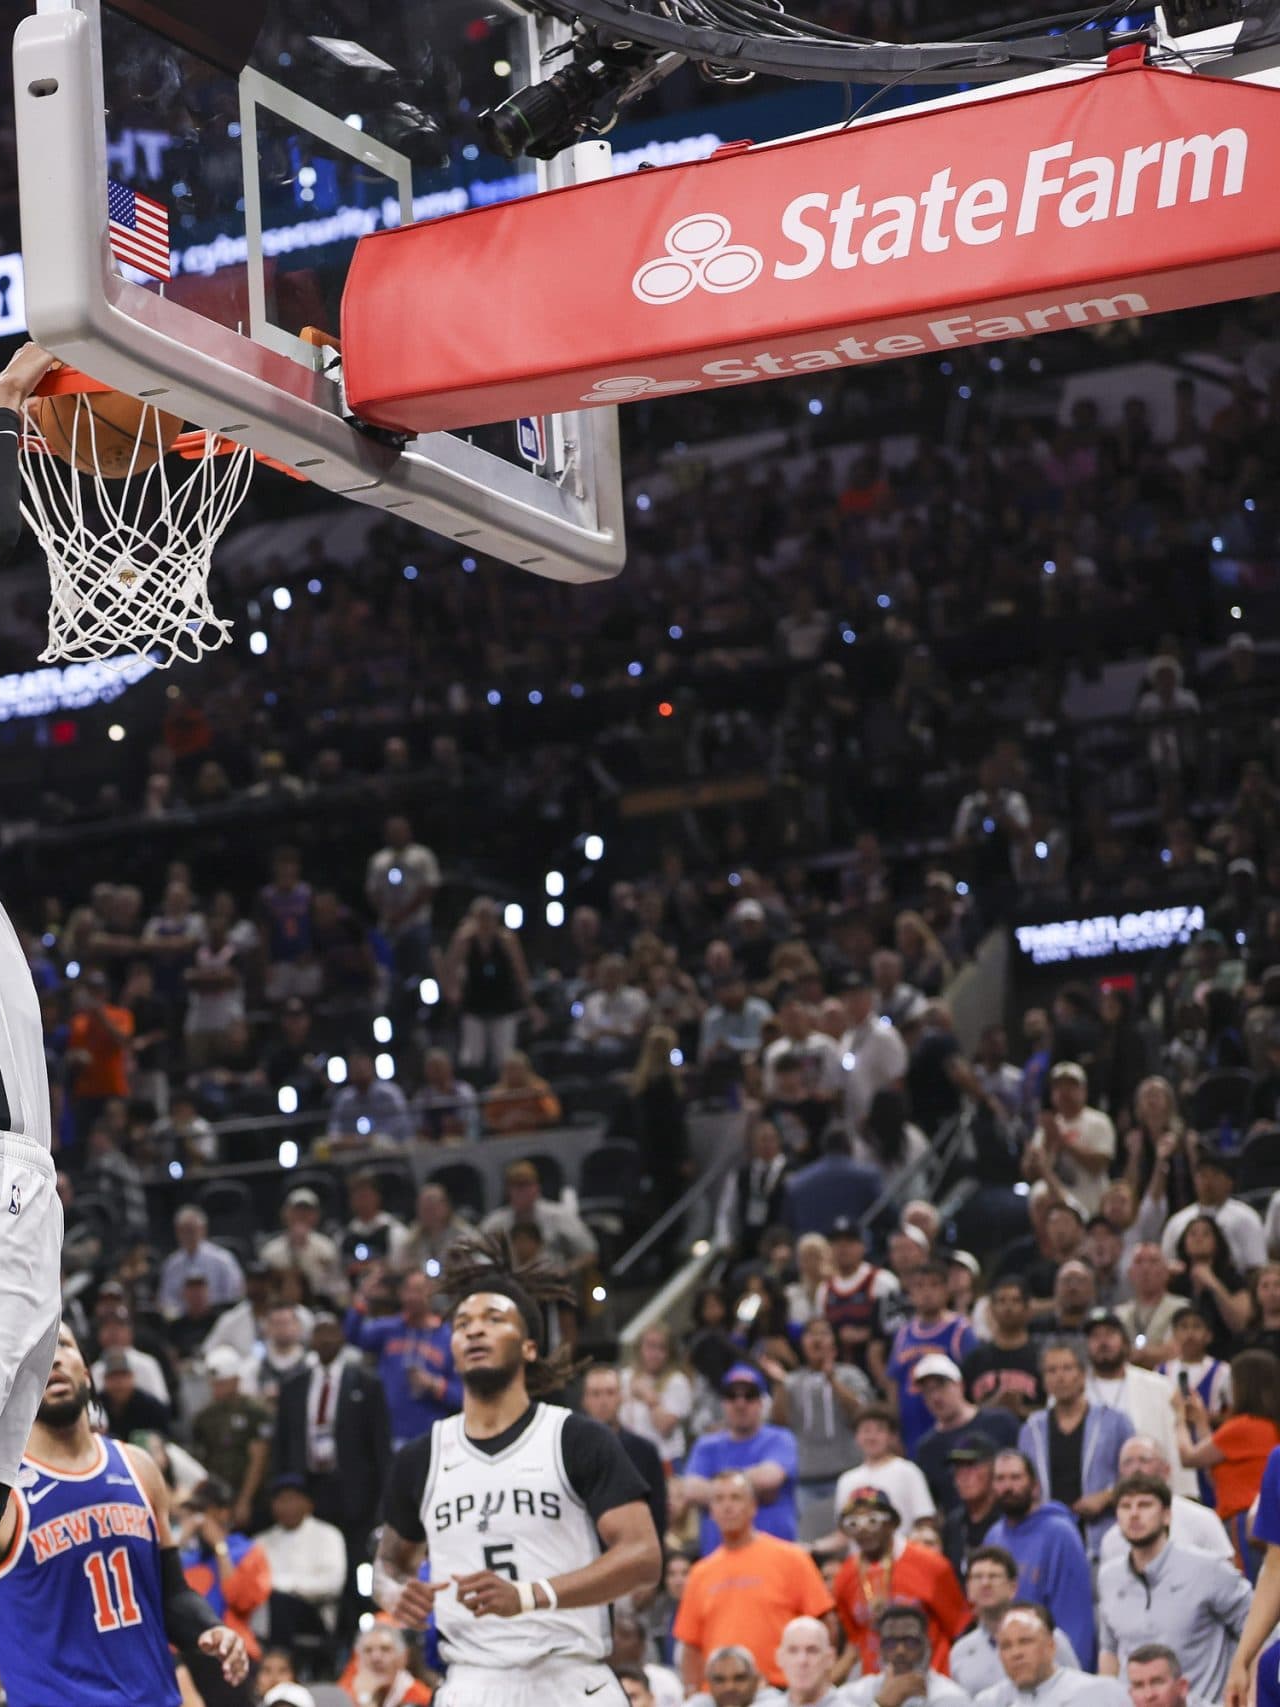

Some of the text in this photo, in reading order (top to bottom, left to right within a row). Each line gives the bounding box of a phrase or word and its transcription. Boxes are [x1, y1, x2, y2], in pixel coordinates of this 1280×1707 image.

[29, 1510, 91, 1565] NEW
[483, 1543, 519, 1581] 5
[83, 1547, 143, 1633] 11
